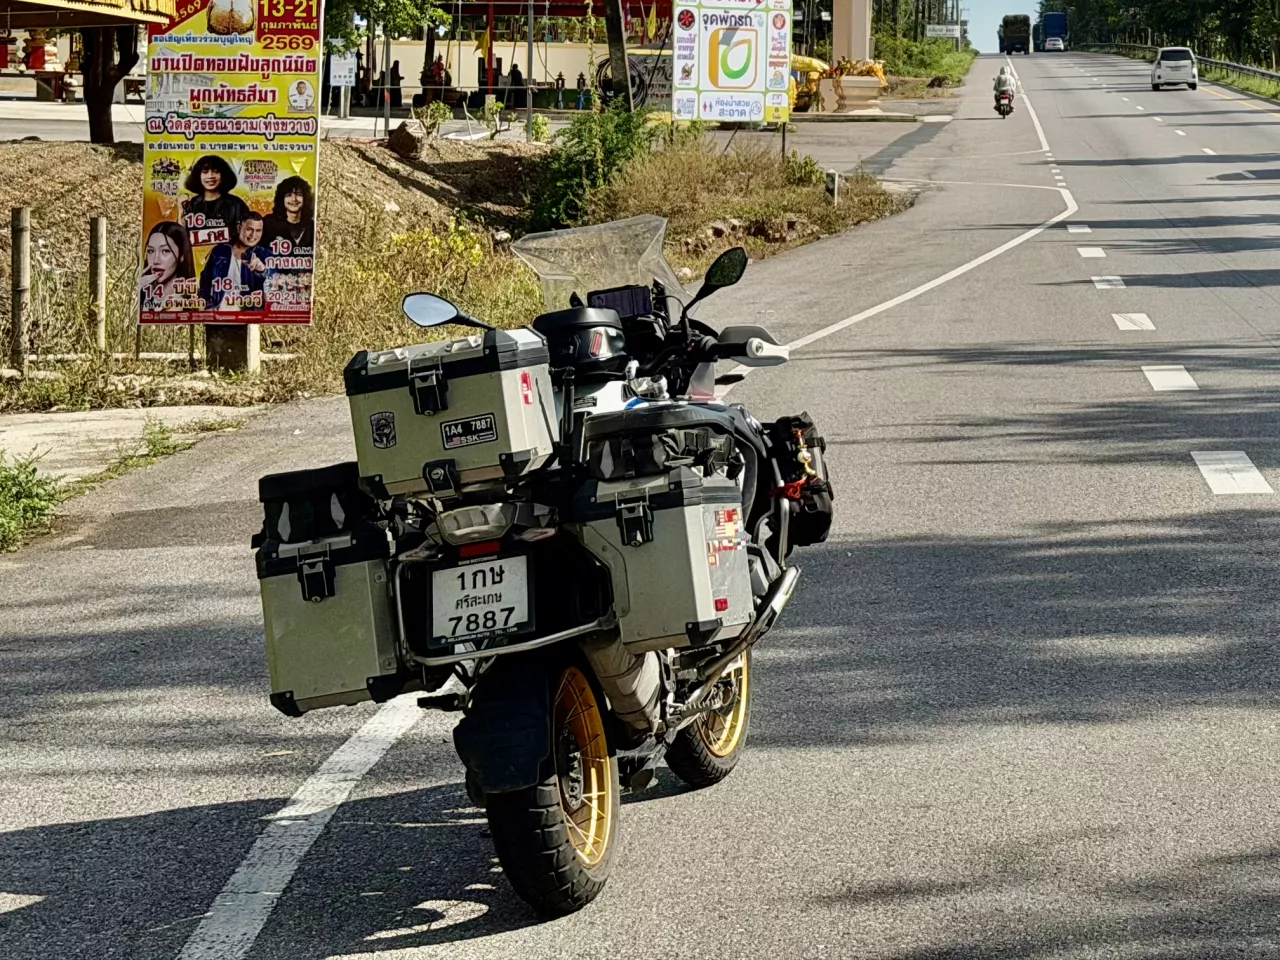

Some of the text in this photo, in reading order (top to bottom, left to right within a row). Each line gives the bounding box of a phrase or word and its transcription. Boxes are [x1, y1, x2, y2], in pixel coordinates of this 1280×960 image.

[260, 18, 318, 34] กุมภาพันธ์
[262, 36, 314, 50] 2569
[151, 52, 316, 80] งานปิดทองฝังลูกนิมิต
[189, 82, 276, 111] ผูกพัทธสีมา
[185, 213, 205, 227] 16
[270, 240, 291, 255] 19
[265, 256, 312, 269] กางเกง
[212, 278, 233, 292] 18
[144, 286, 164, 299] 14
[269, 292, 296, 303] 20,21
[470, 418, 491, 431] 7887
[460, 434, 480, 444] SSK
[455, 592, 502, 610] ศรีสะเกษ
[448, 606, 516, 636] 7887
